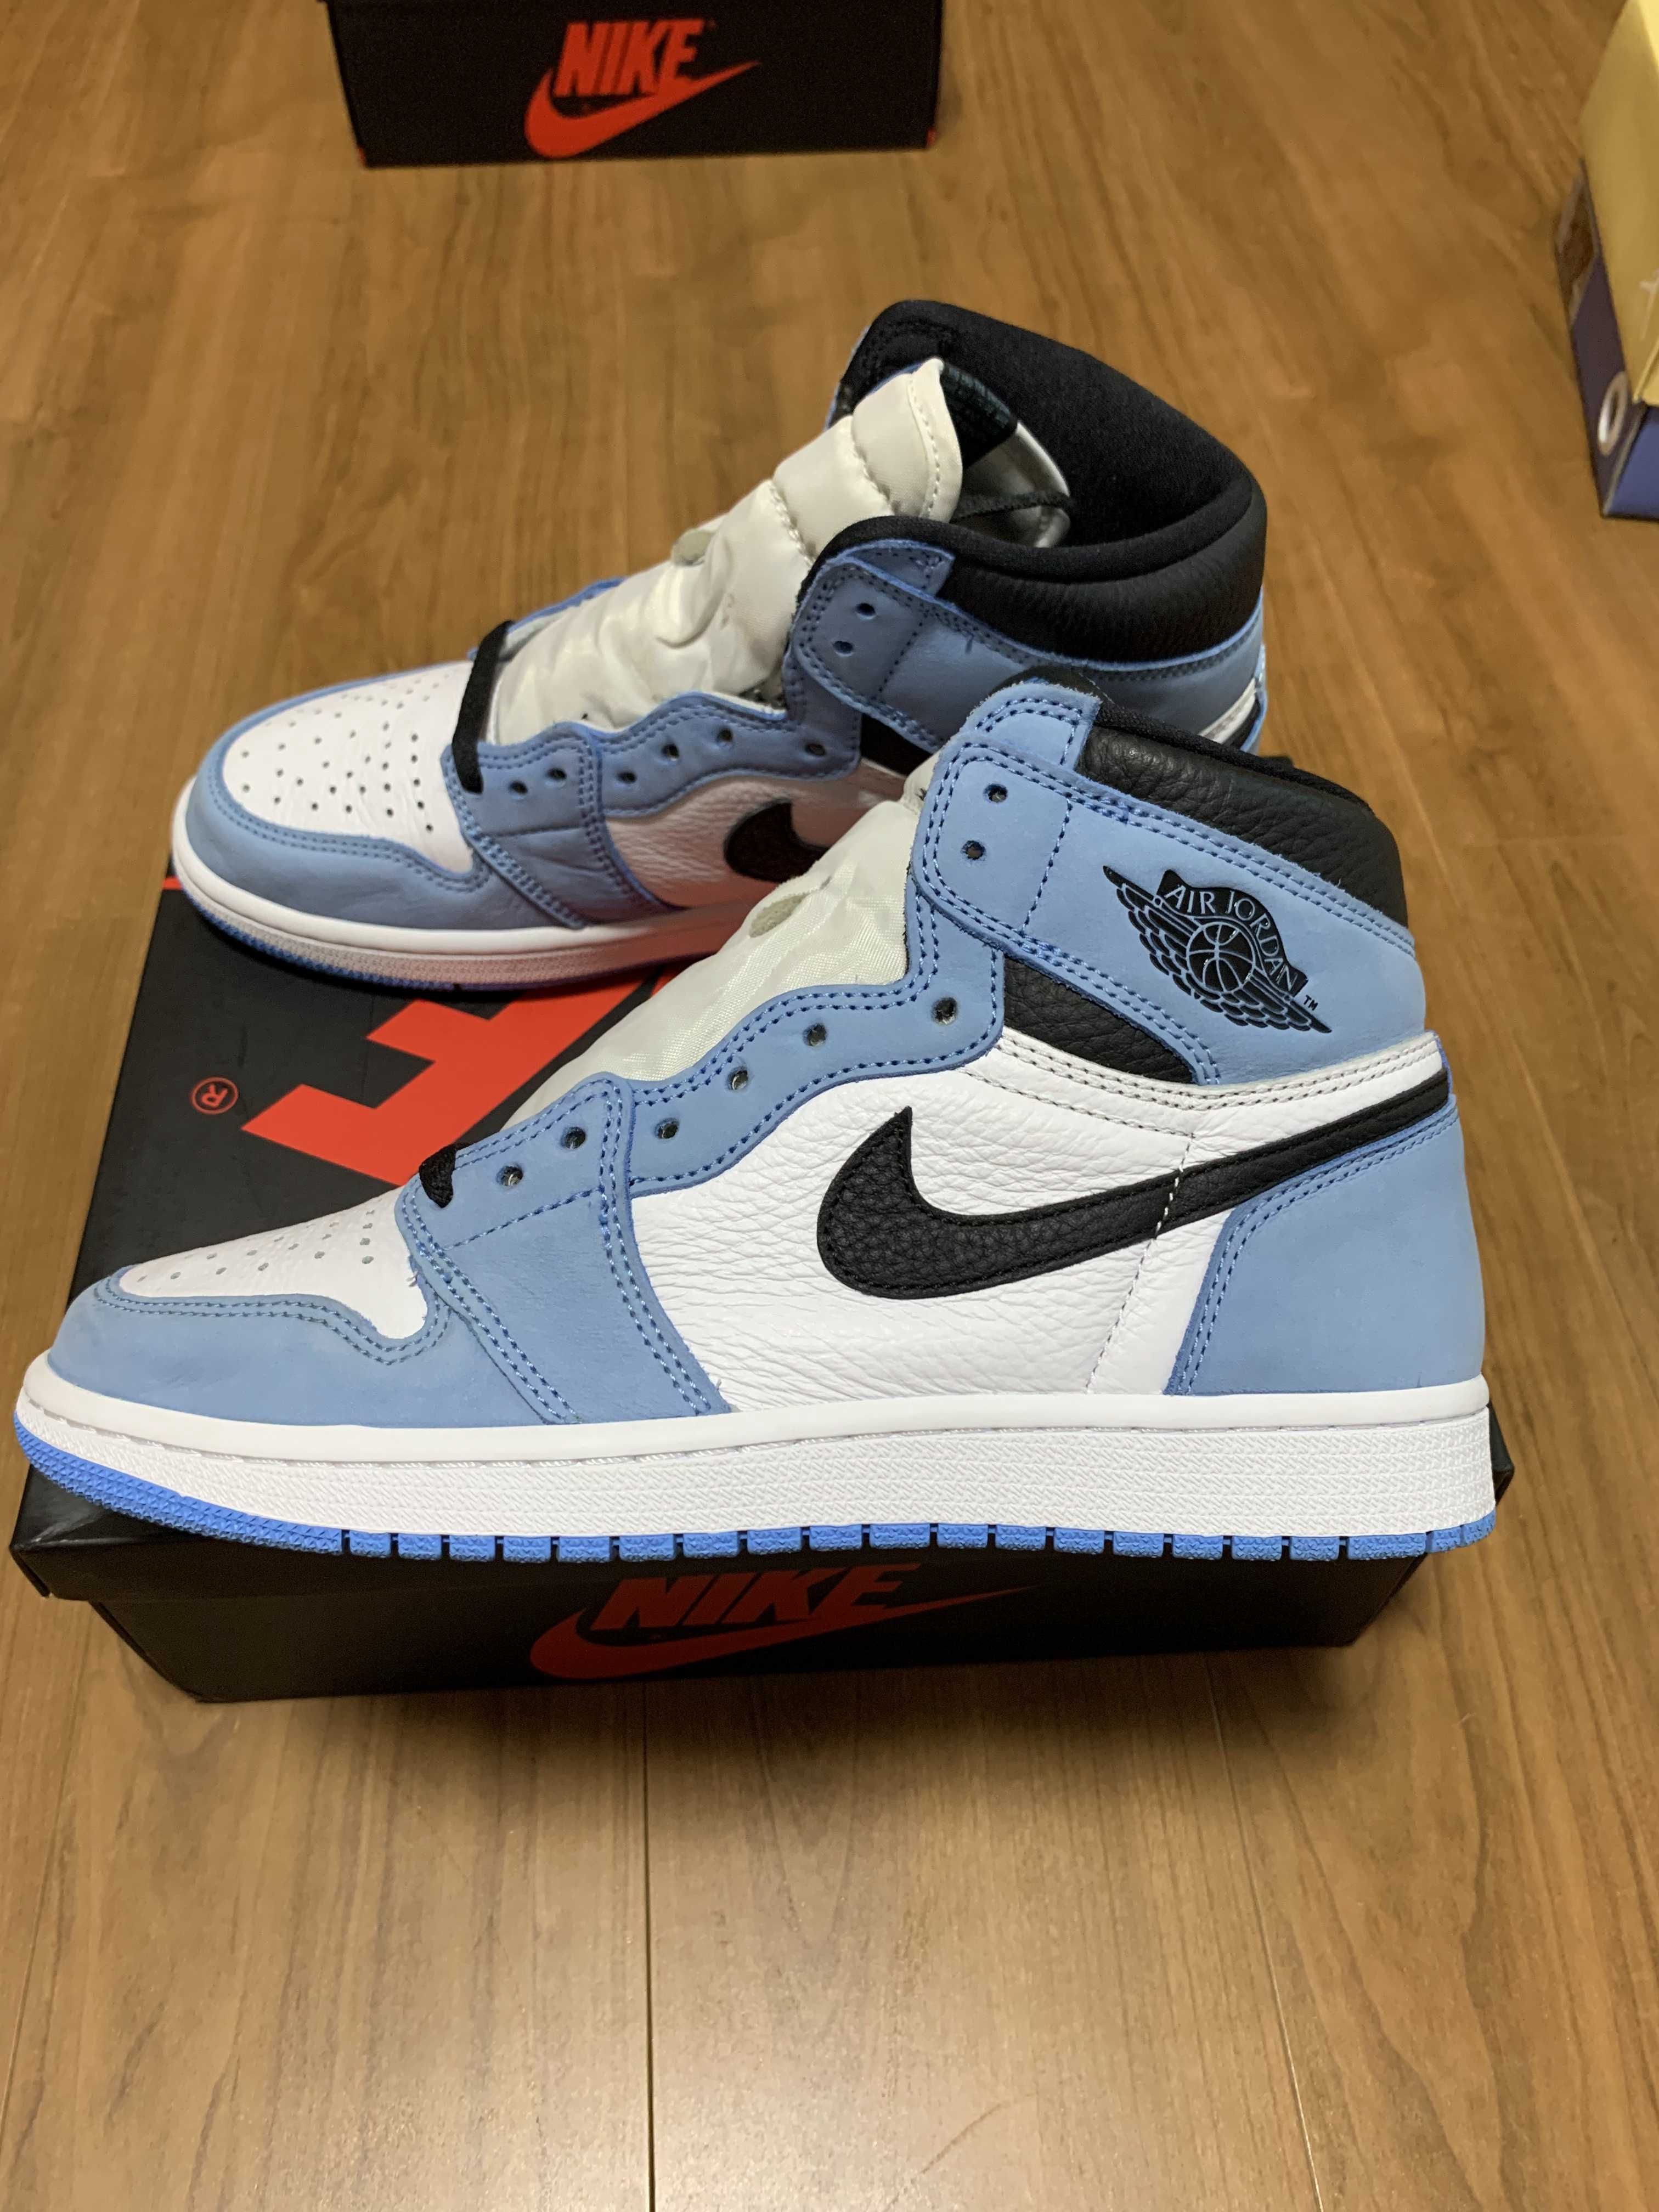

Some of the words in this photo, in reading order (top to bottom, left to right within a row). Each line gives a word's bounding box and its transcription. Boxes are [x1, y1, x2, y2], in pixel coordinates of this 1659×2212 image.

[551, 18, 704, 98] NIKE
[1164, 884, 1216, 915] AIR
[1224, 890, 1298, 991] JORDAN
[590, 1562, 922, 1630] NIKE
